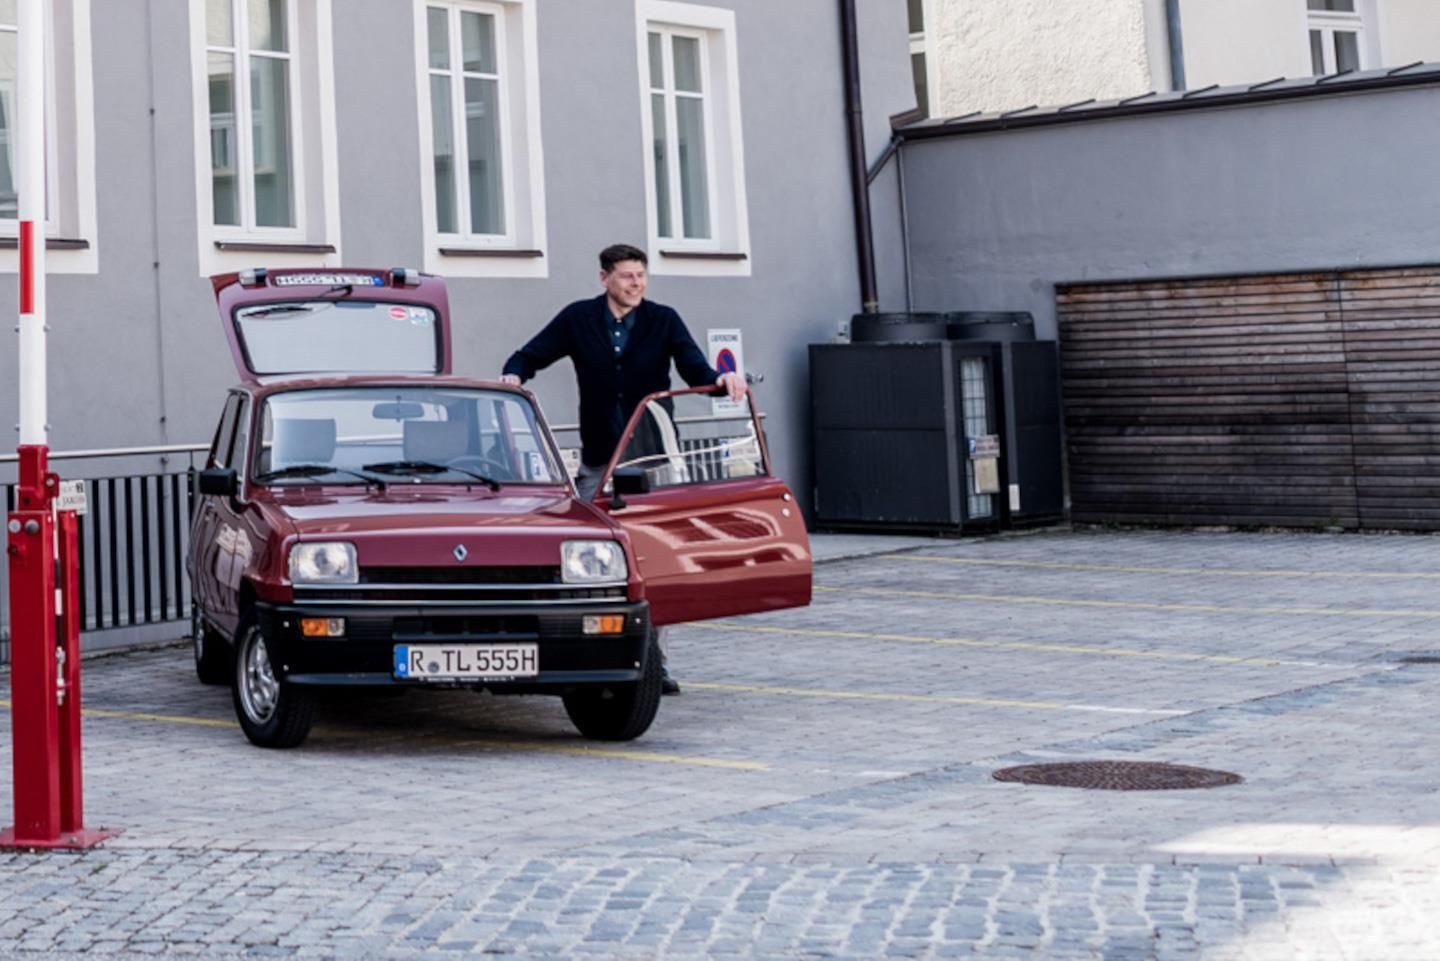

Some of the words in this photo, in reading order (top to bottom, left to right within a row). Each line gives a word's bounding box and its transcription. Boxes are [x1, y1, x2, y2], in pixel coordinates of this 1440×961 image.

[410, 650, 424, 673] R
[441, 650, 471, 672] TL
[477, 649, 536, 672] 555H
